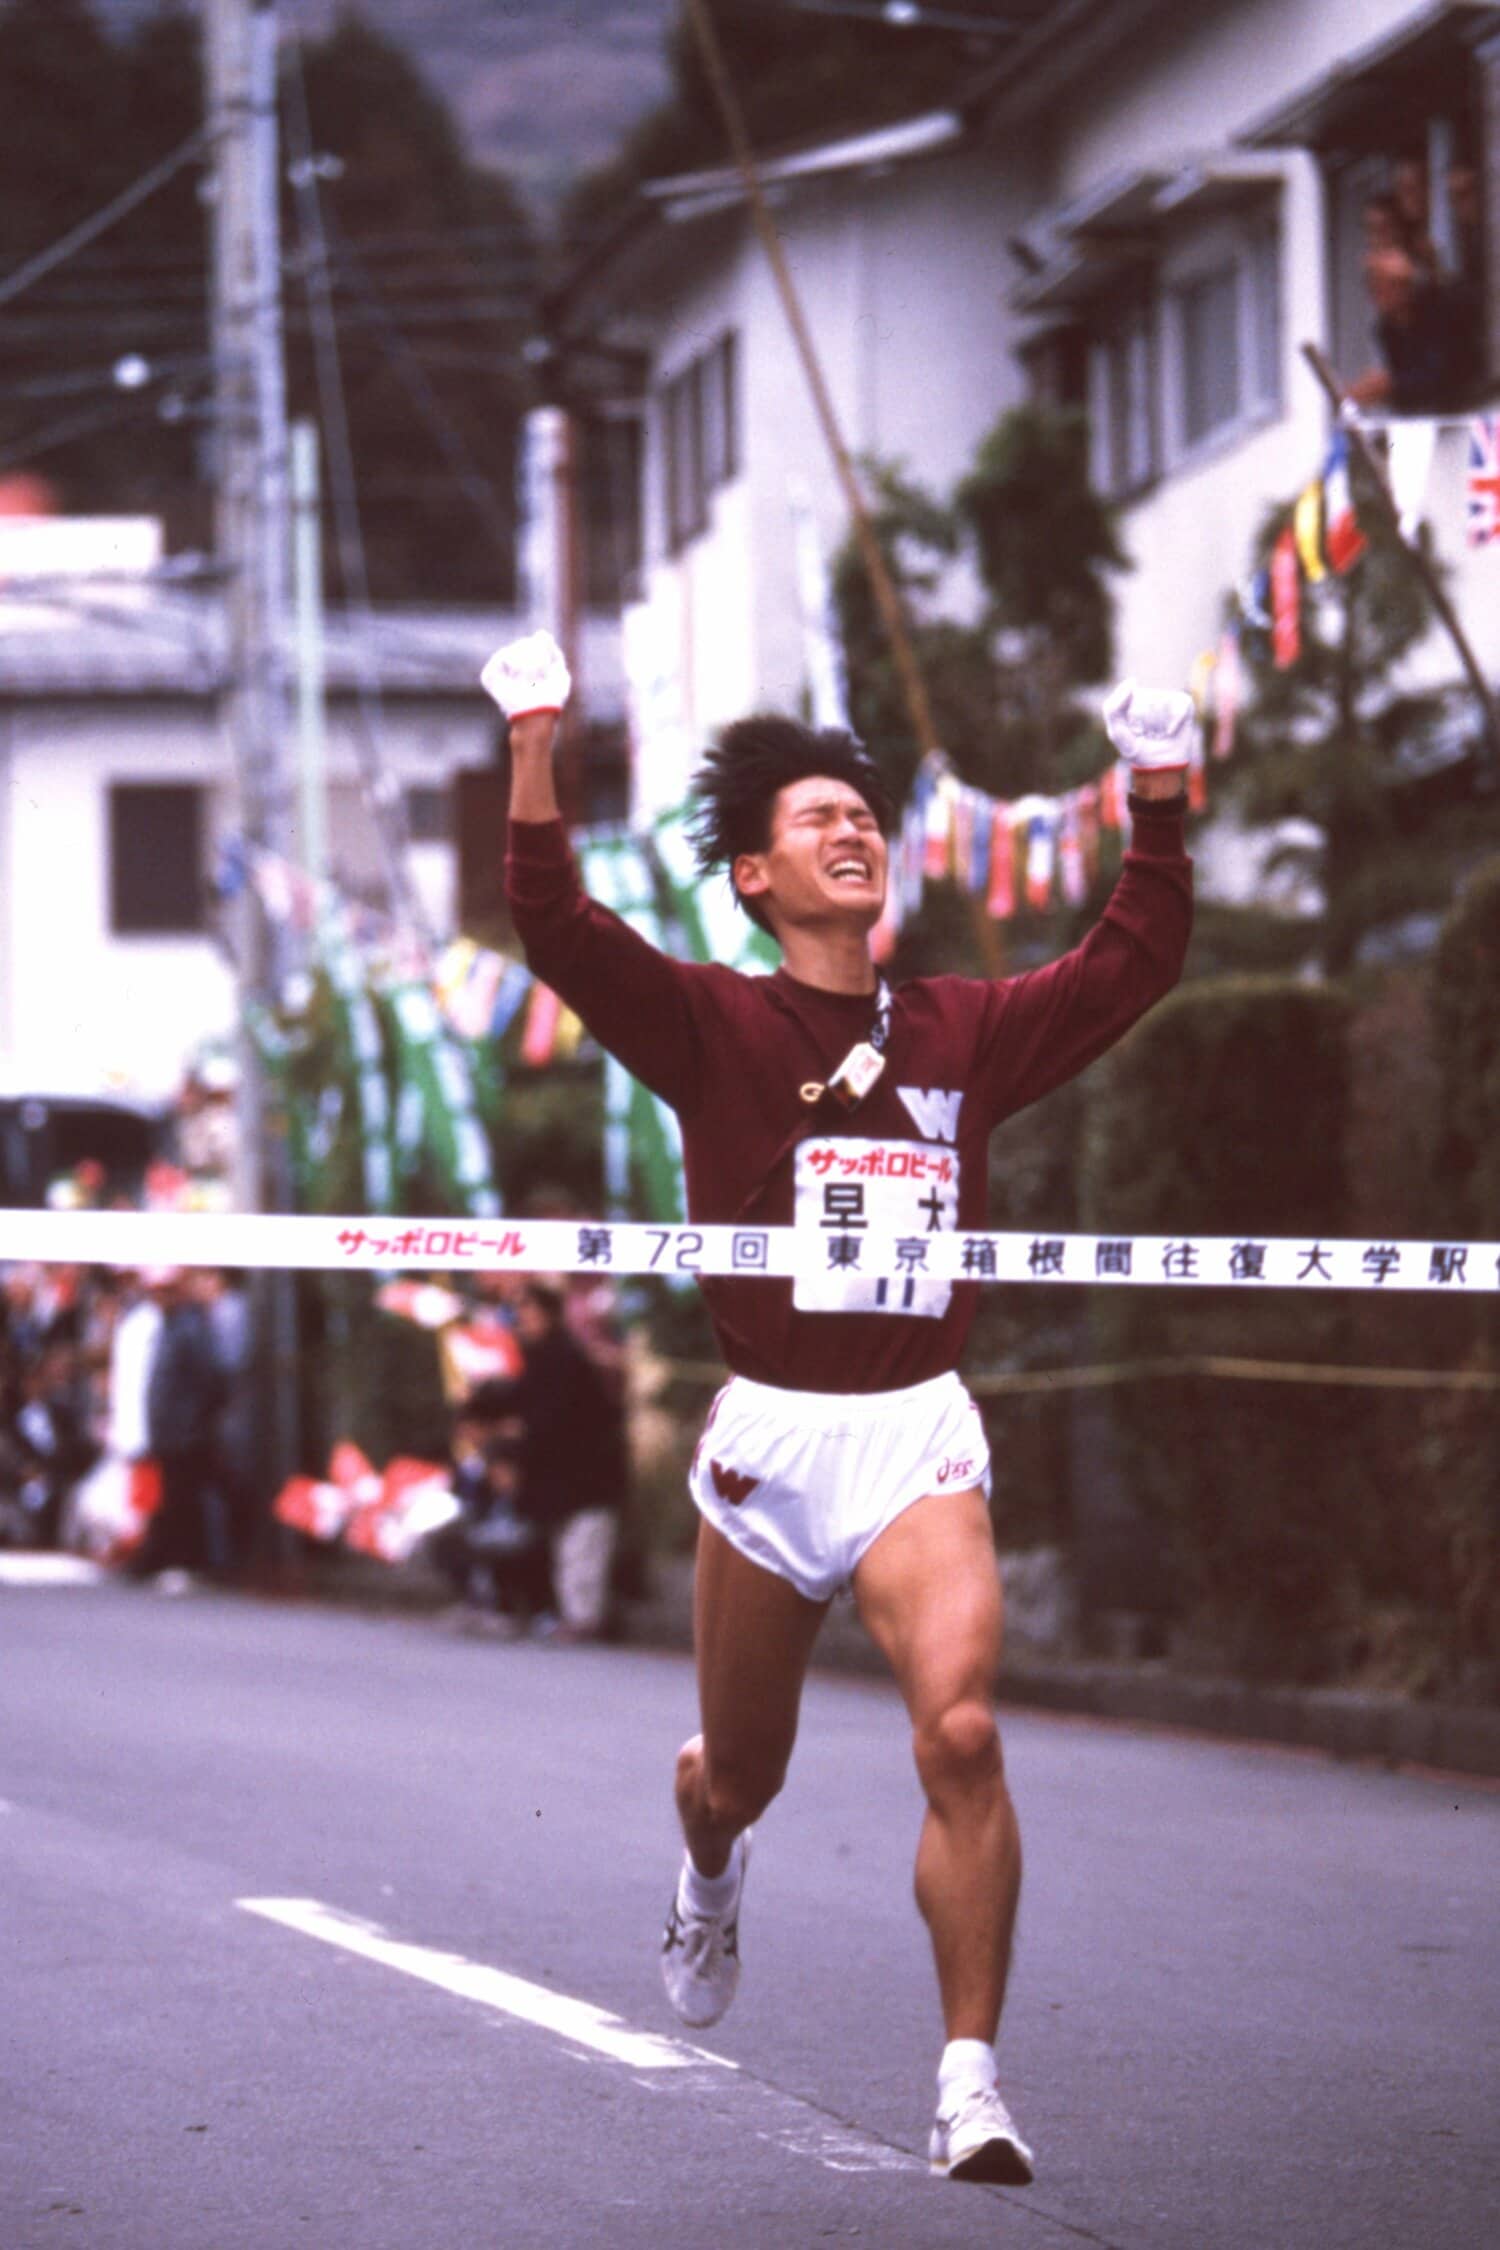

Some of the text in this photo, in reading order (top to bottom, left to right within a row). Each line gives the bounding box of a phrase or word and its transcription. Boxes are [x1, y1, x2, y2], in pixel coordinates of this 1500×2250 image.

[896, 1086, 964, 1142] W
[807, 1148, 953, 1183] サッポロビール
[337, 1228, 526, 1257] サッポロビール
[827, 1234, 1500, 1284] 東京箱根間往復大学駅
